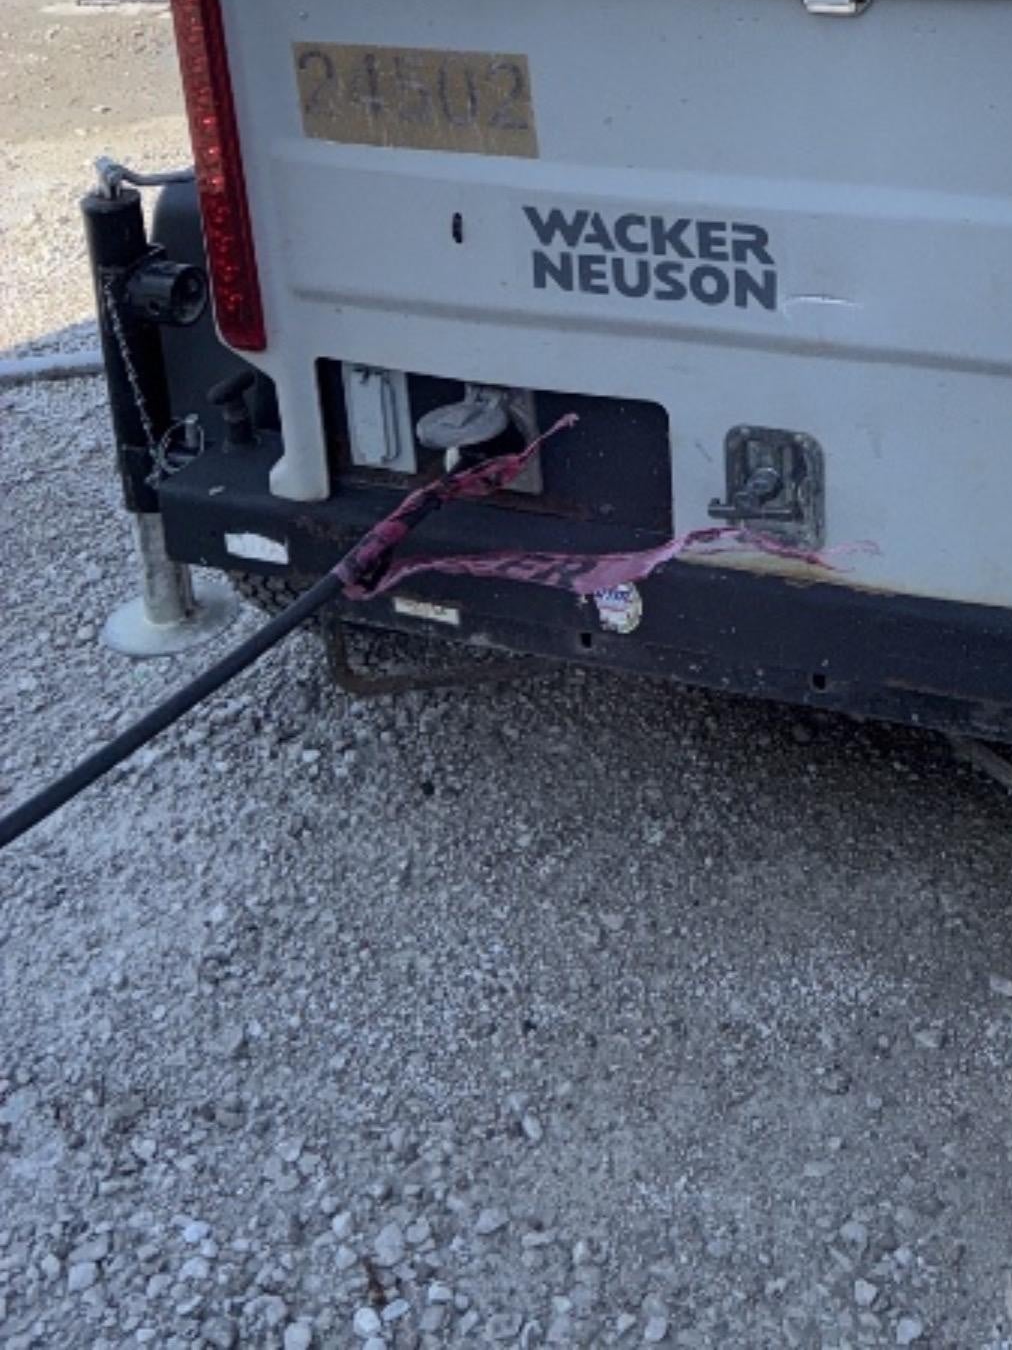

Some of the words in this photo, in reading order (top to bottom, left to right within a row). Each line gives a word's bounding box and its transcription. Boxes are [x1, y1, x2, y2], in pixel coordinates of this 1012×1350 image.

[299, 50, 529, 130] 24502
[521, 204, 776, 265] WACKER
[532, 249, 778, 312] NEUSON
